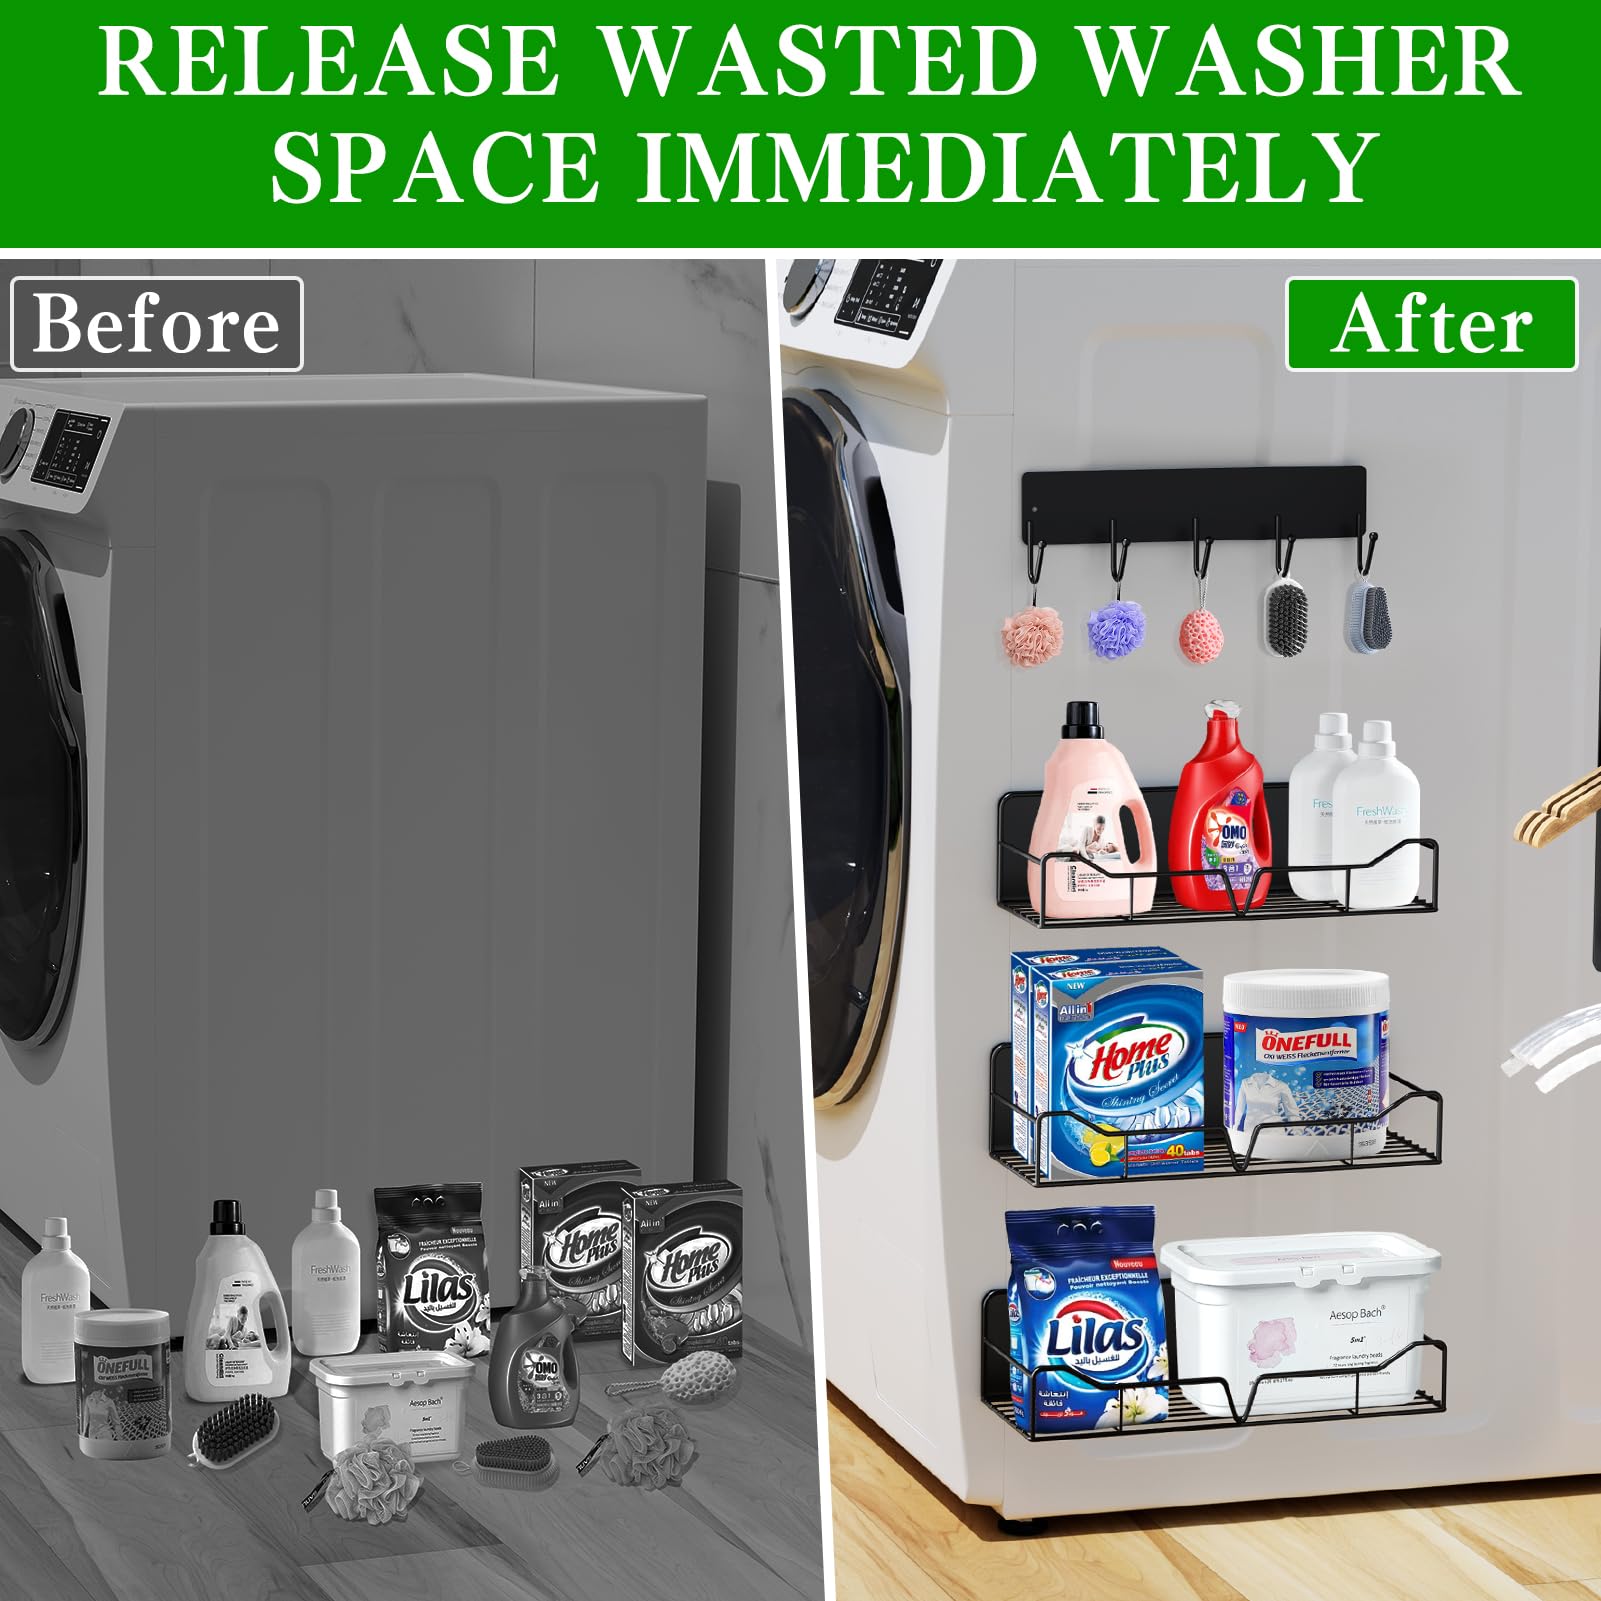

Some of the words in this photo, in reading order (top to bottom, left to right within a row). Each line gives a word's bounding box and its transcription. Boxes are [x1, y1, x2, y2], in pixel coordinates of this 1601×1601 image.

[1222, 825, 1247, 840] OMO
[1066, 982, 1086, 990] NEW
[1060, 1006, 1075, 1015] All
[1076, 1004, 1087, 1014] in
[1088, 1033, 1172, 1081] Home
[1101, 1095, 1145, 1108] Shining
[1167, 1144, 1184, 1157] 40
[539, 1200, 551, 1208] All
[641, 1220, 652, 1228] All
[559, 1223, 619, 1264] Home
[660, 1242, 721, 1284] Home
[310, 1265, 351, 1275] FreshWash
[404, 1271, 473, 1304] Lilas
[1070, 1283, 1094, 1291] Pouvoir
[1330, 1311, 1359, 1321] Aesop
[1047, 1314, 1144, 1355] Lilas
[536, 1362, 557, 1374] OMO
[409, 1400, 427, 1408] Aesop
